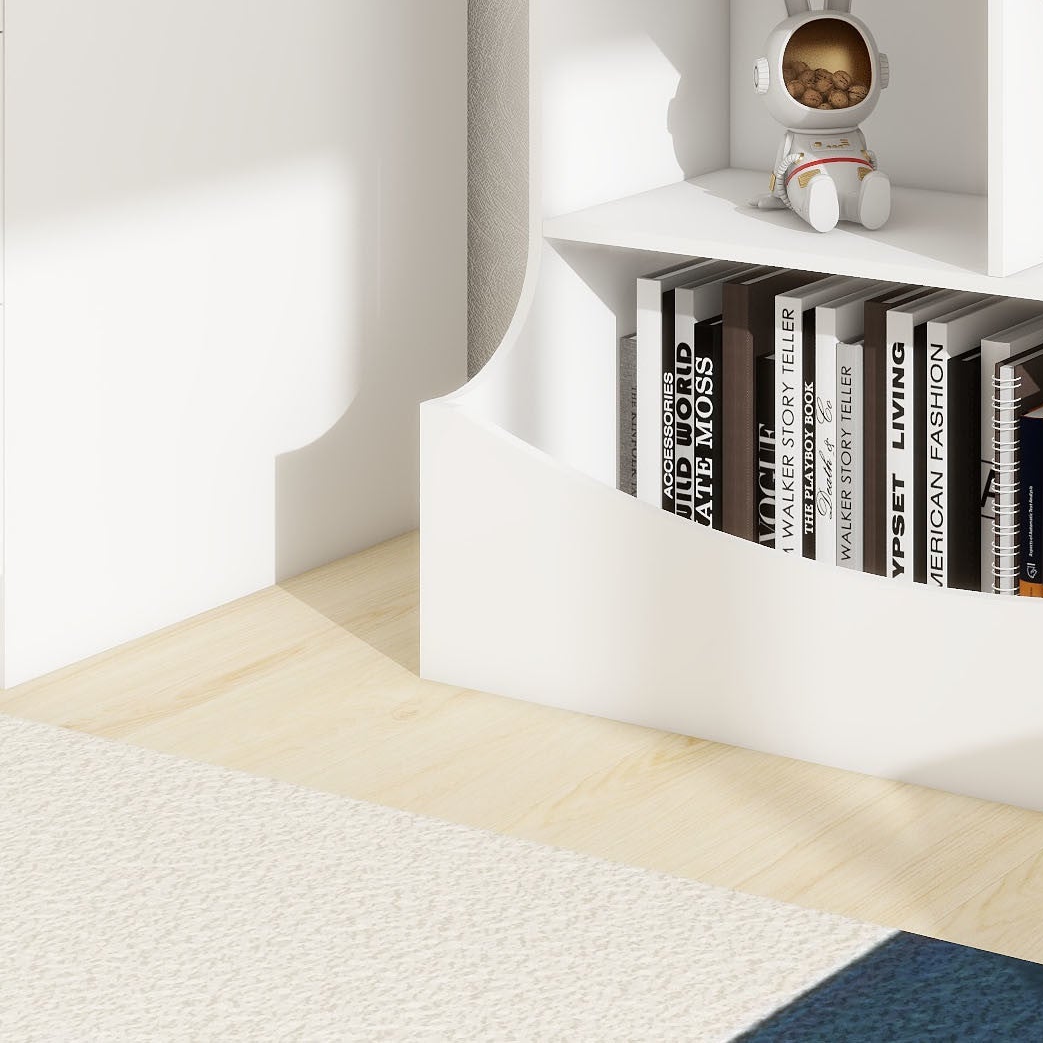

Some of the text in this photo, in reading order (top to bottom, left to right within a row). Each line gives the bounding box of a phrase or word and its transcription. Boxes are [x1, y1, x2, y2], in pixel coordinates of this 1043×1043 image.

[676, 342, 693, 447] WORLD
[781, 308, 795, 376] TELLER
[663, 372, 674, 499] ACCESSORIES
[695, 357, 714, 528] ATE MOSS
[781, 382, 795, 448] STORY
[804, 381, 815, 535] THE PLAYBOY BOOK
[892, 342, 905, 578] YPSET LIVING
[930, 343, 944, 461] FASHION
[781, 454, 795, 539] WALKER
[817, 452, 833, 520] Death
[840, 365, 852, 561] WALKER STORY TELLER
